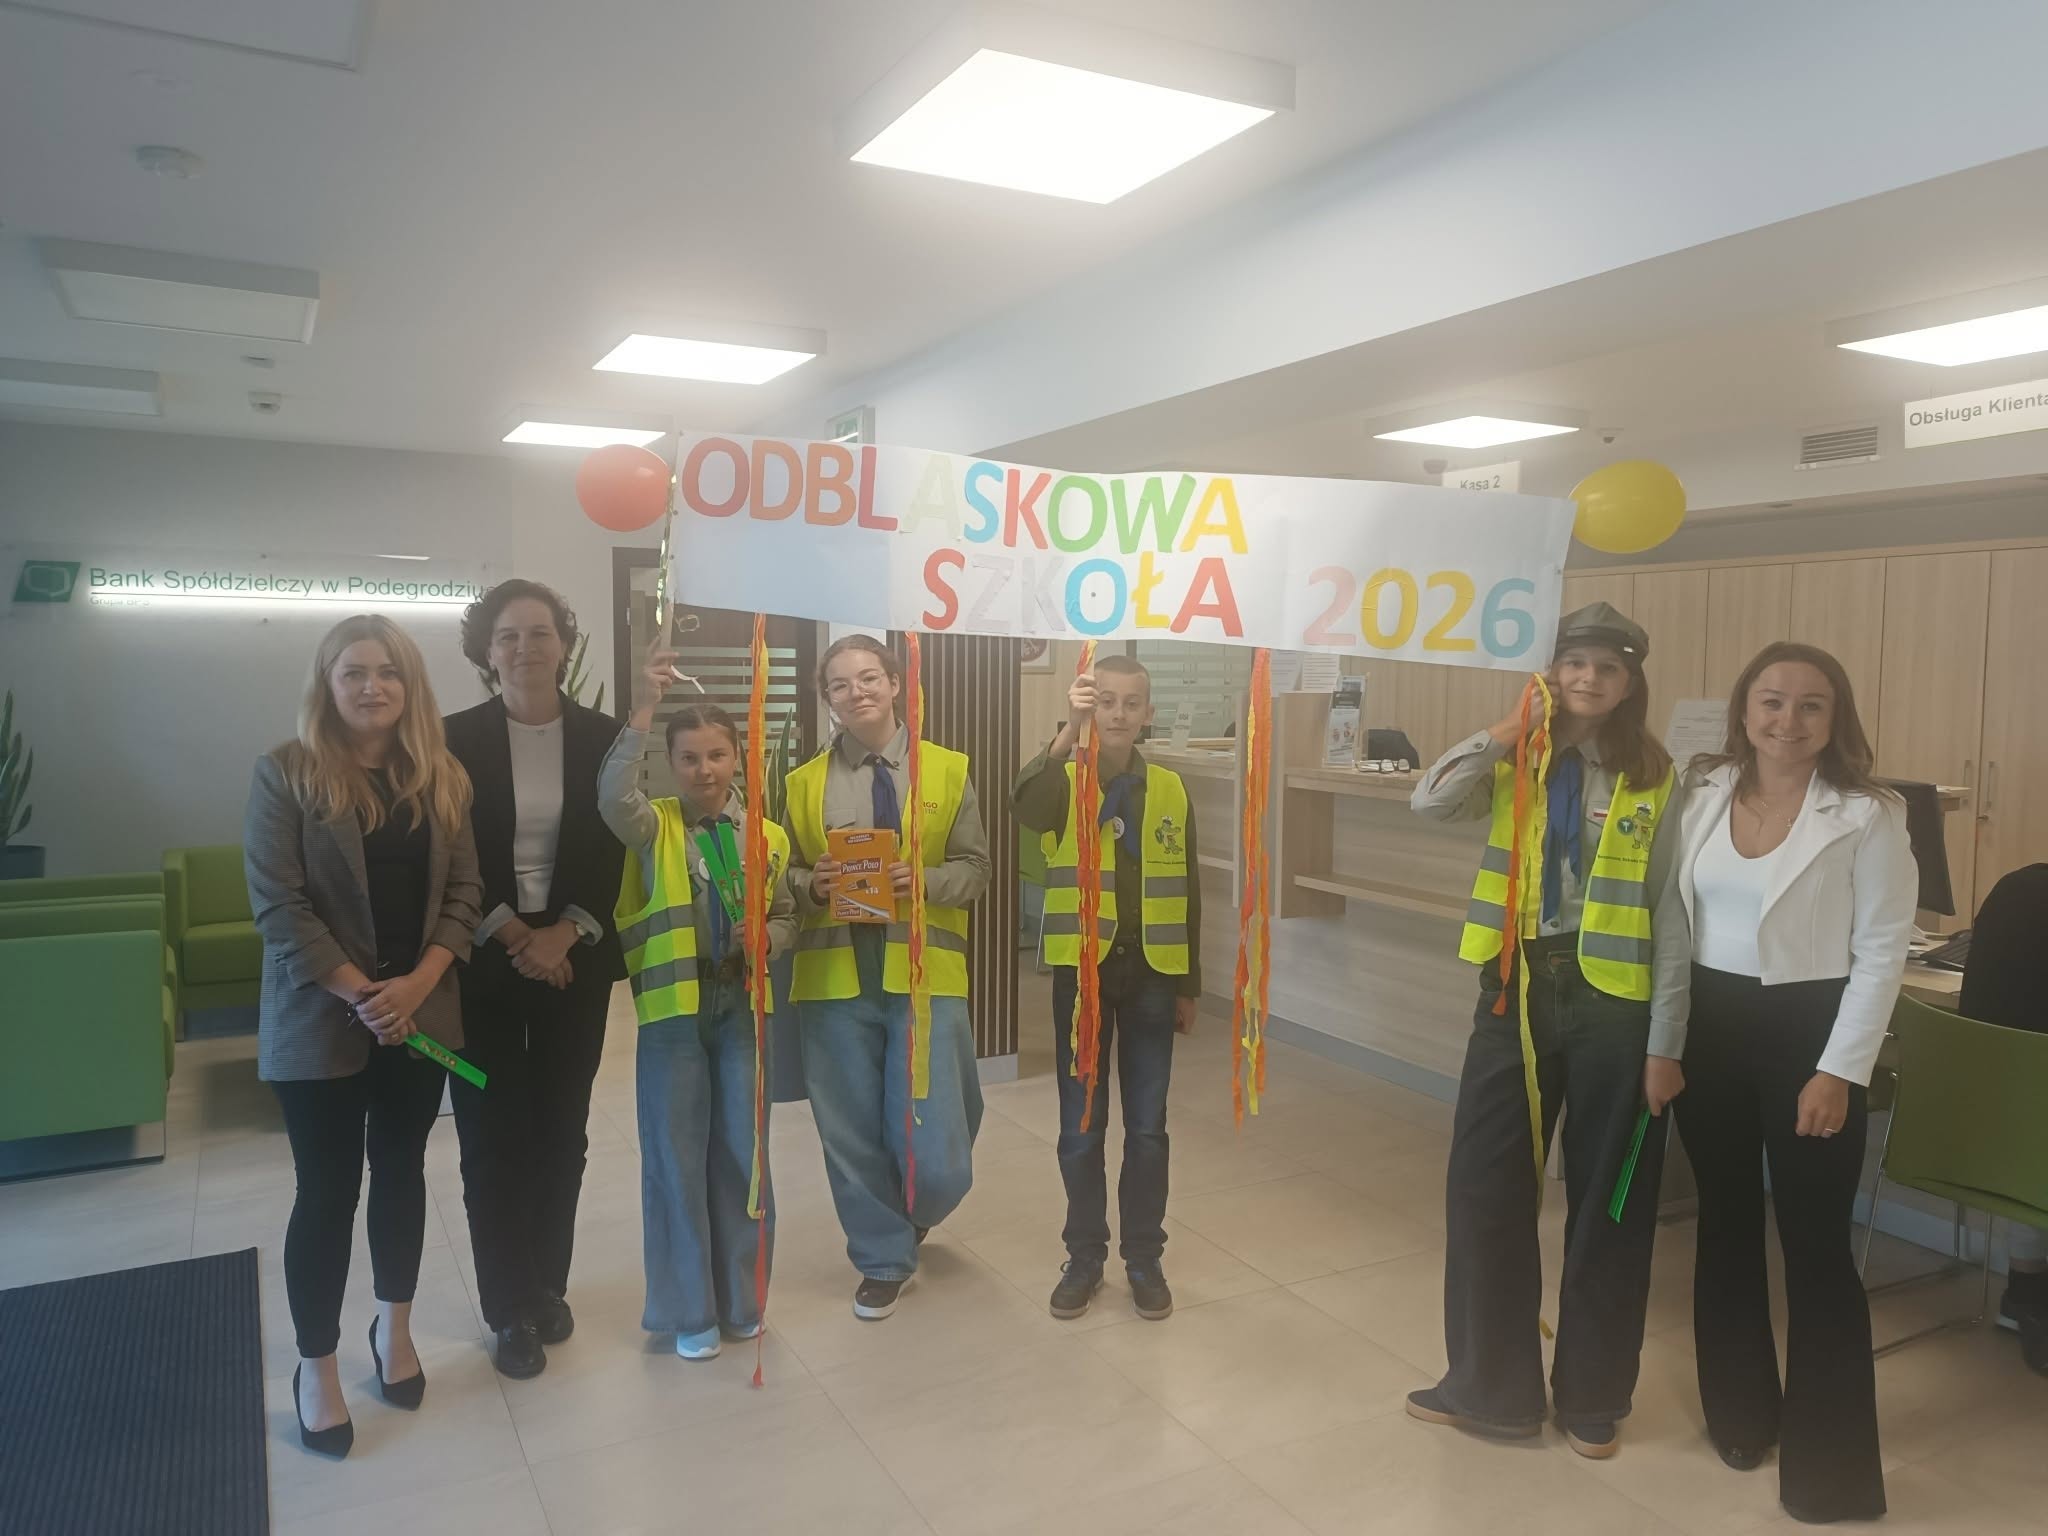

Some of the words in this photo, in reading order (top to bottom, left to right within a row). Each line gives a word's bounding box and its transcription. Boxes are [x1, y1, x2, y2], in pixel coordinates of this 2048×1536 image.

[1909, 405, 1983, 427] Obsługa
[682, 437, 1248, 554] ODBLASKOWA
[1460, 479, 1489, 491] Kasa
[1492, 474, 1501, 489] 2
[90, 568, 154, 588] Bank
[164, 570, 314, 597] Spółdzielczy
[321, 580, 340, 594] w
[348, 577, 484, 600] Podegrodziu
[922, 548, 1244, 638] SZKOŁA
[1302, 565, 1536, 659] 2026
